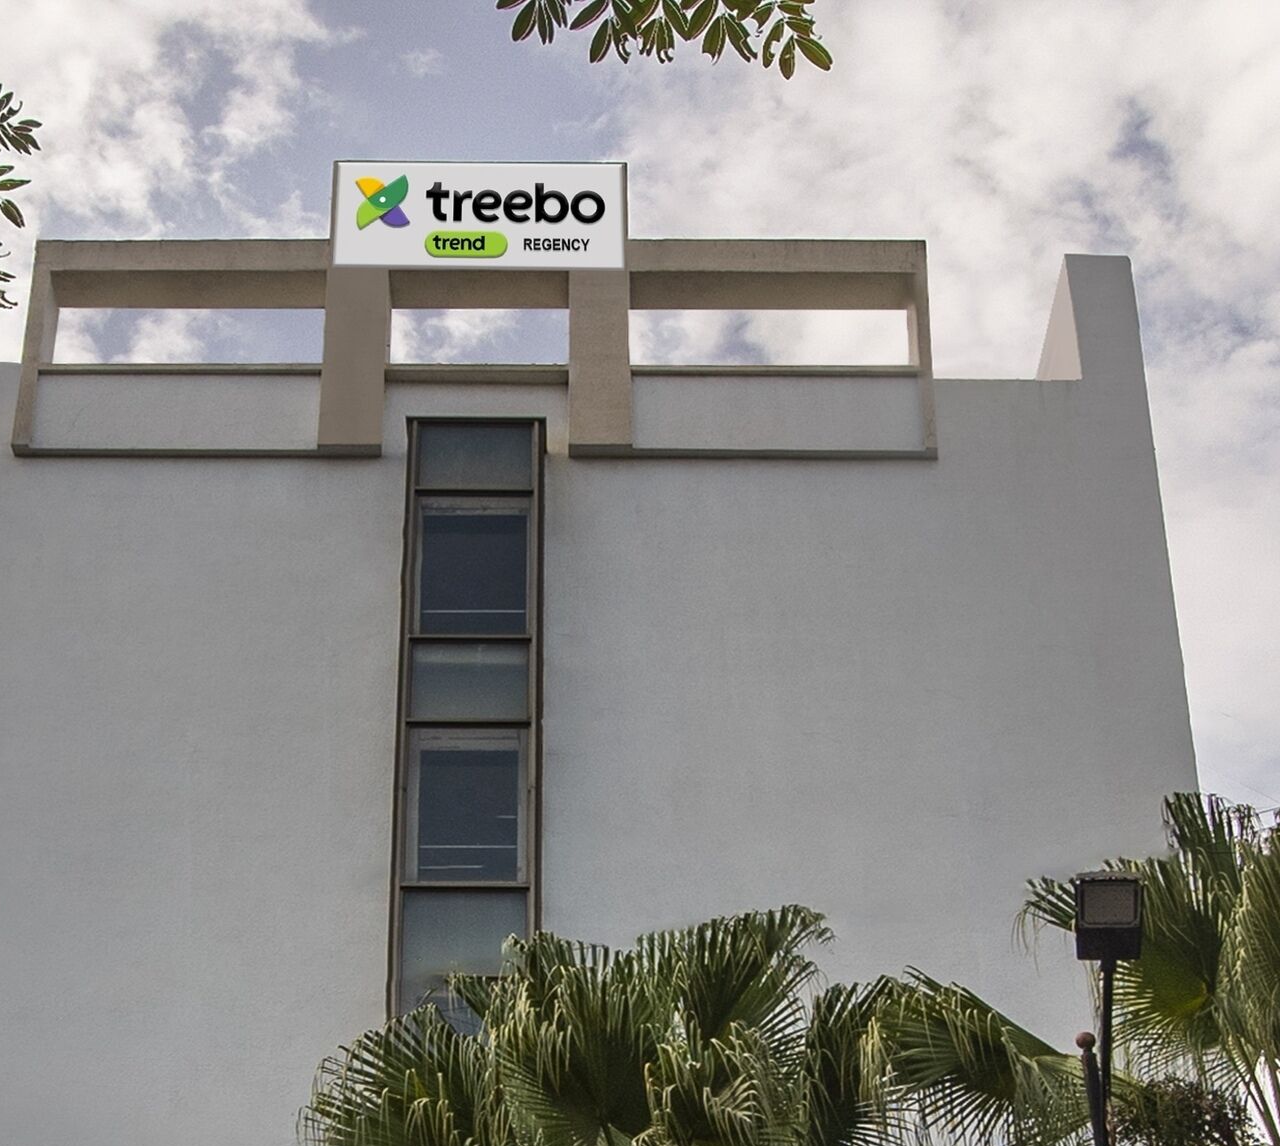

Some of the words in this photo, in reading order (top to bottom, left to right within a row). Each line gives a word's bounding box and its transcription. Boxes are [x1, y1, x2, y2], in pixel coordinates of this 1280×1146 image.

[426, 182, 606, 224] treebo
[433, 235, 486, 251] trend
[524, 238, 591, 252] REGENCY
